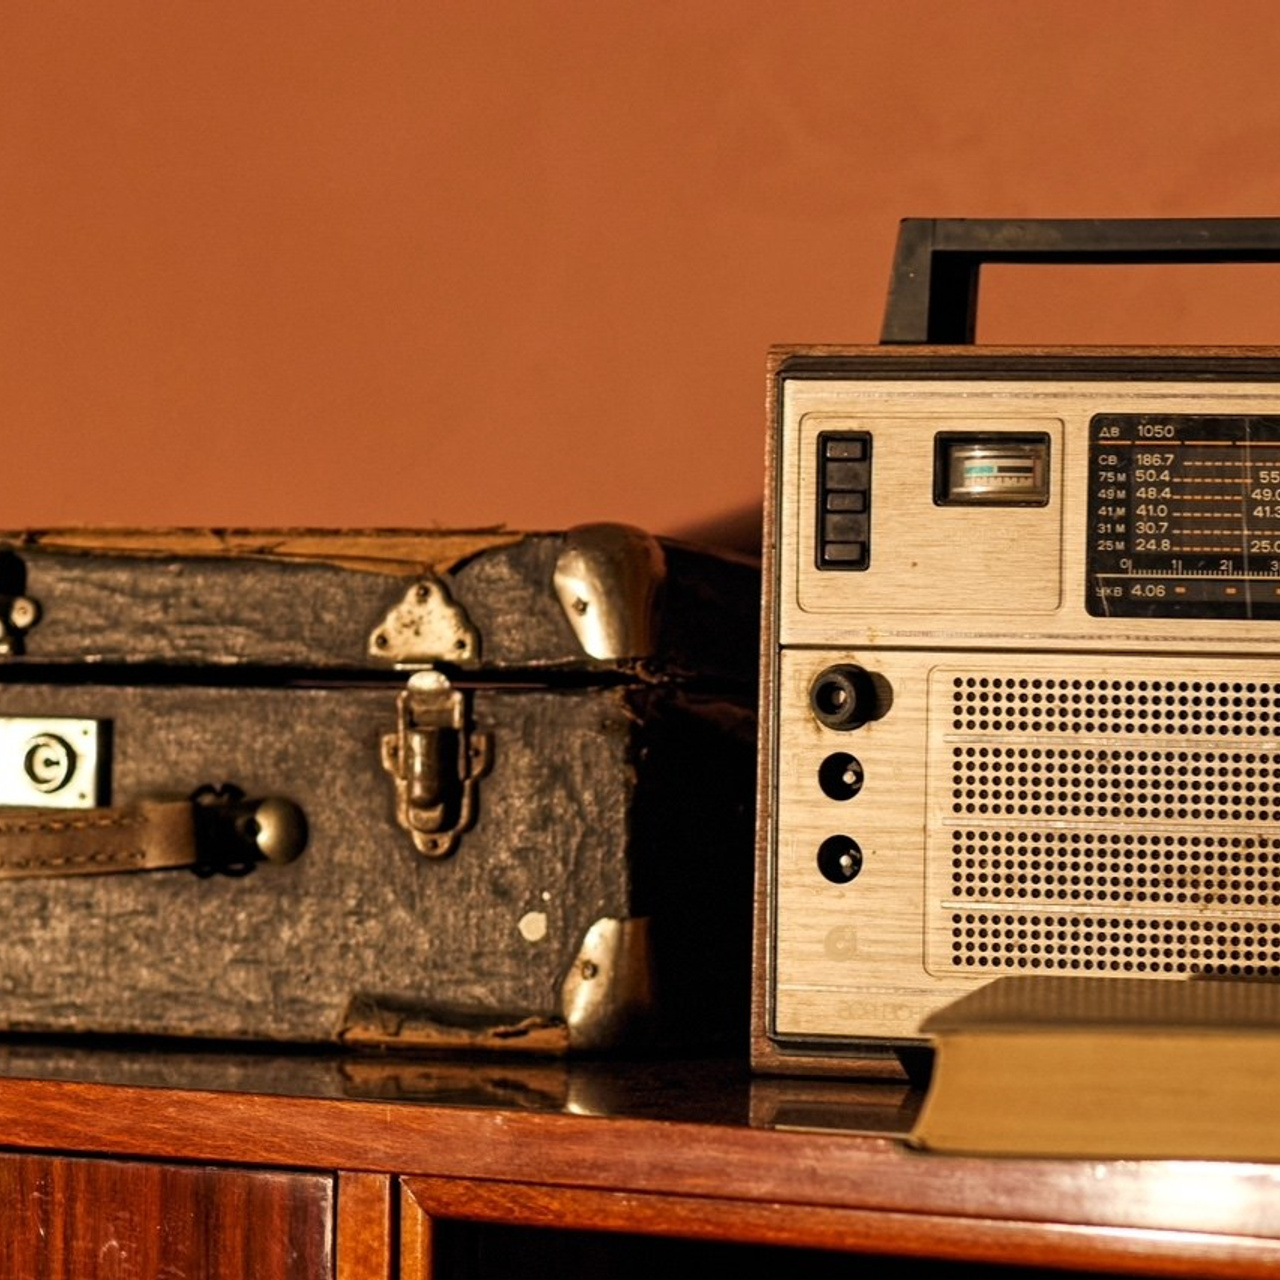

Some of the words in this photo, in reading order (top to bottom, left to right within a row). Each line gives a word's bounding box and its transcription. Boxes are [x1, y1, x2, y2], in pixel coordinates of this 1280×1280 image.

[1098, 426, 1120, 438] ДВ
[1137, 425, 1175, 438] 1050
[1098, 454, 1118, 466] СВ
[1136, 453, 1175, 466] 186.7
[1135, 469, 1171, 482] 50.4
[1259, 471, 1280, 483] 55
[1136, 487, 1173, 500] 48.4
[1136, 504, 1168, 517] 41.0
[1135, 522, 1169, 534] 30.7
[1135, 539, 1171, 551] 24.8
[1171, 559, 1177, 569] 1
[1220, 560, 1228, 570] 2
[1270, 560, 1279, 571] 3
[1131, 584, 1166, 597] 4.06
